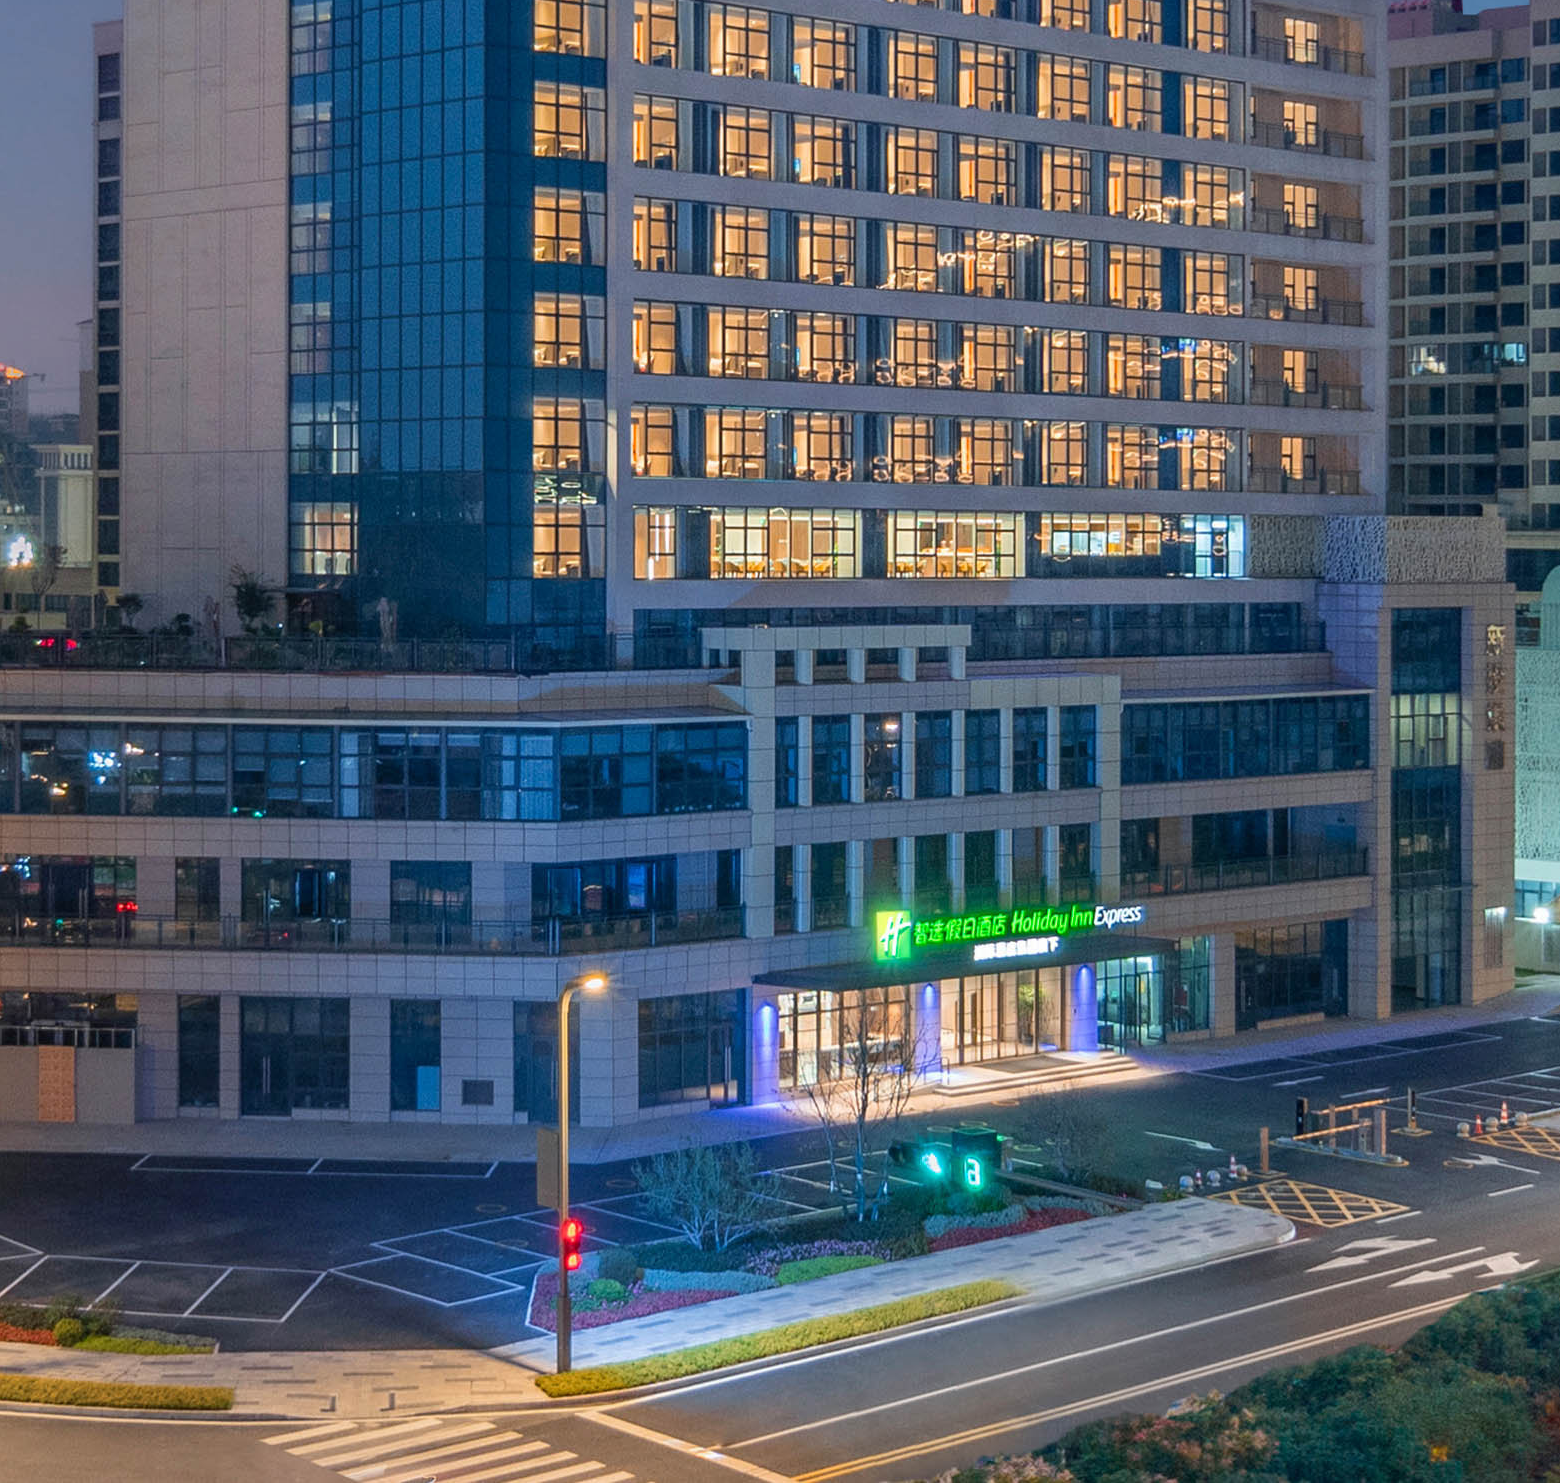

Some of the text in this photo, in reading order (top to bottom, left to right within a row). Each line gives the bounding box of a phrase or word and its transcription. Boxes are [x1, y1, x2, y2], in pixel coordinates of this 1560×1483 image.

[914, 914, 1007, 945] 智选假日酒店
[1011, 907, 1069, 935] Holiday
[1070, 904, 1093, 928] Inn
[1093, 906, 1142, 929] Express
